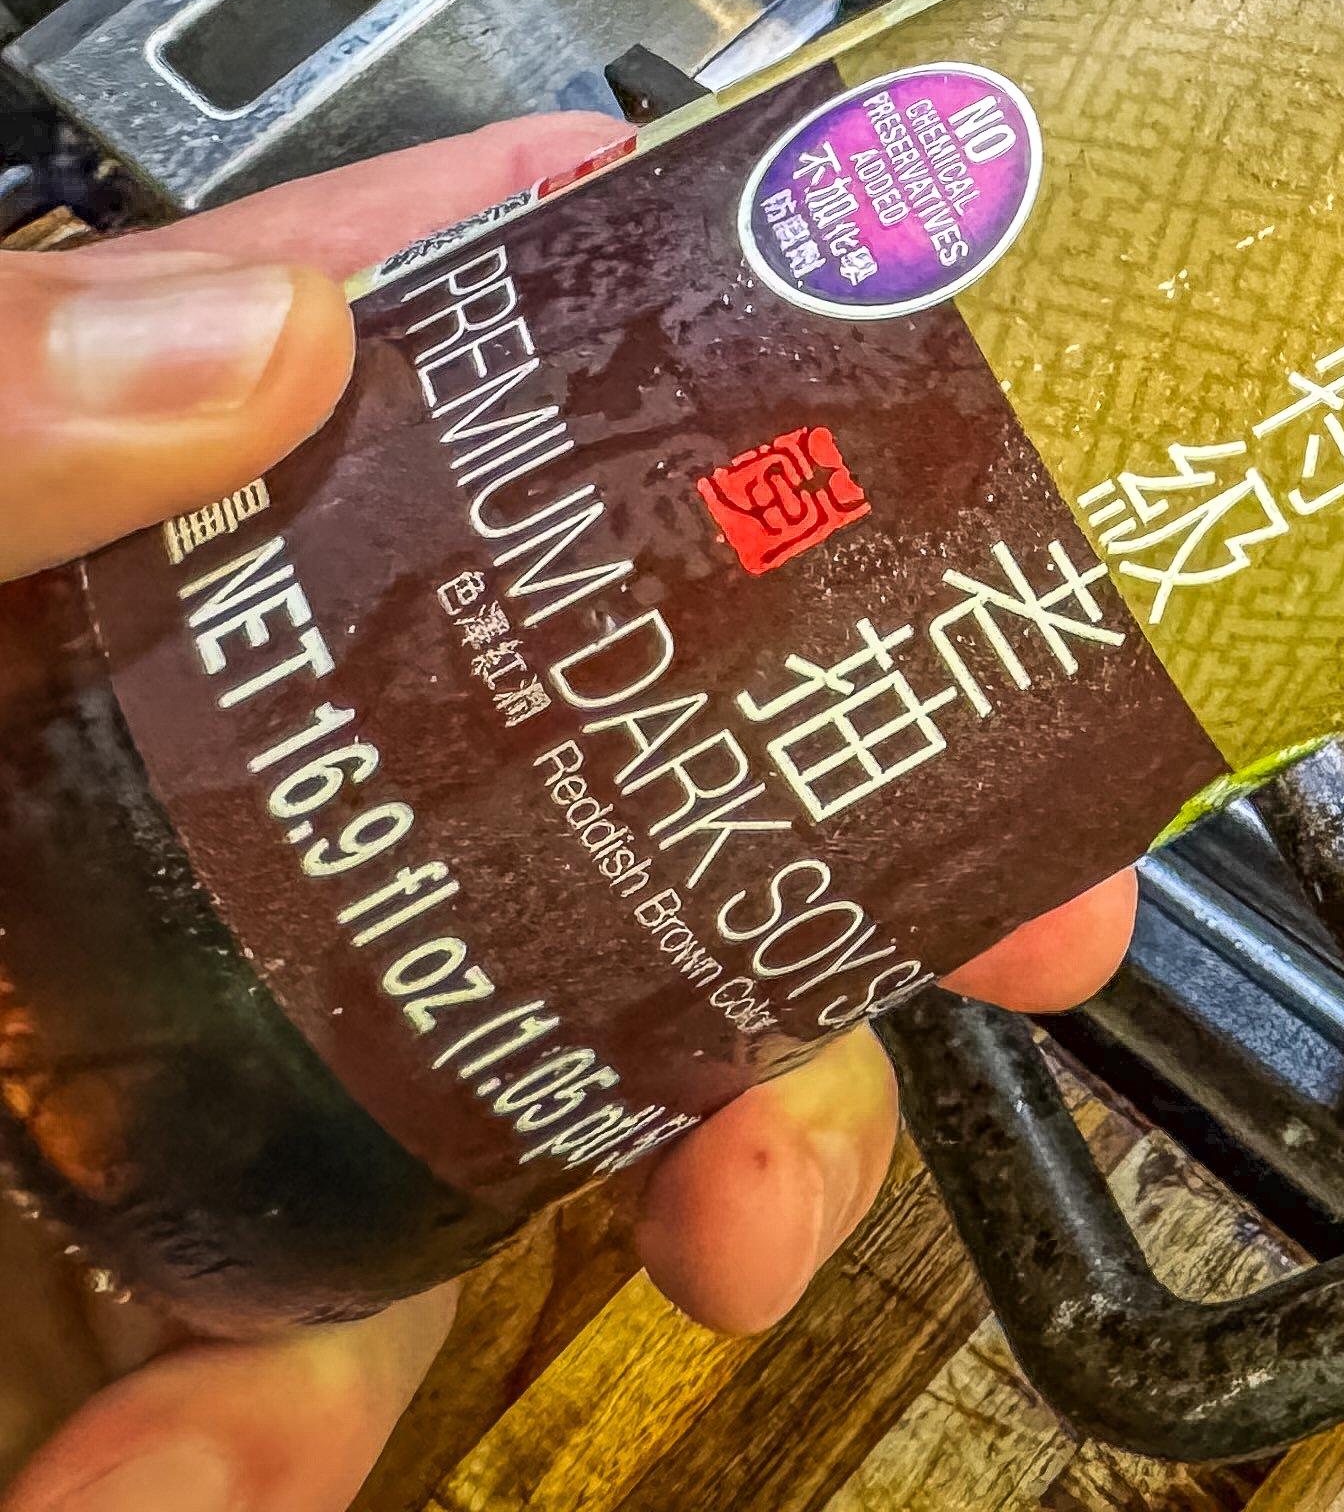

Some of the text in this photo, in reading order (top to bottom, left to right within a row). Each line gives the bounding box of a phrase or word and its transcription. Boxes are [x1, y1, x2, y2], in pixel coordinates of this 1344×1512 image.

[850, 149, 914, 227] ADDED
[863, 91, 968, 267] PRESERVATIVES
[905, 98, 981, 216] CHEMICAL
[948, 95, 1016, 164] NO
[178, 535, 335, 709] NET
[400, 245, 634, 627] PREMIUM
[549, 609, 793, 889] DARK
[716, 859, 896, 1000] SOY
[246, 701, 415, 878] 16.9
[336, 859, 460, 948] fl
[532, 739, 779, 1034] Reddish Brown Color
[382, 936, 496, 1036] oz
[431, 999, 621, 1134] (1.05
